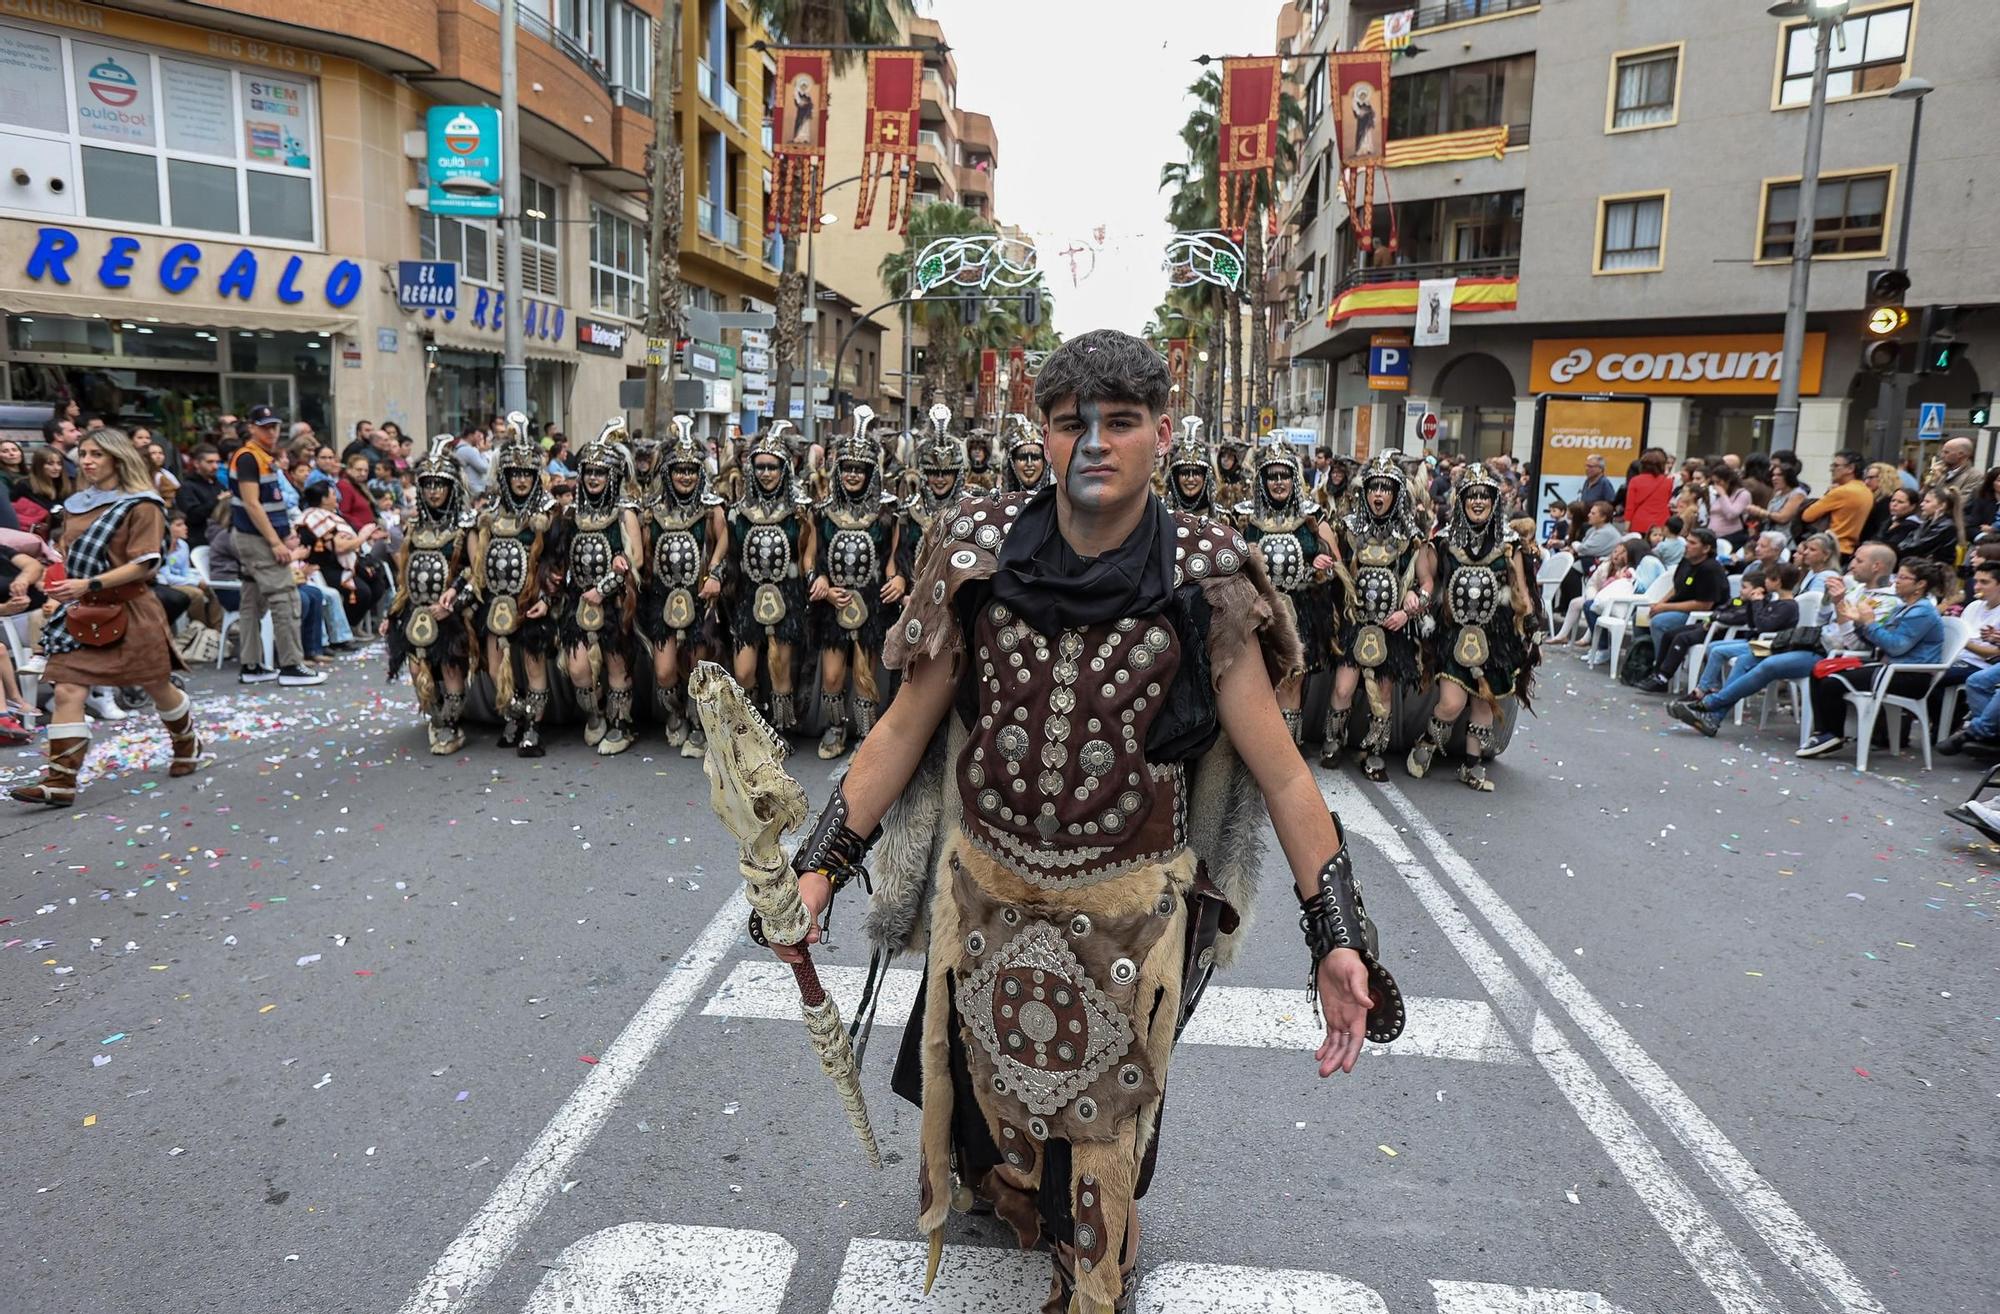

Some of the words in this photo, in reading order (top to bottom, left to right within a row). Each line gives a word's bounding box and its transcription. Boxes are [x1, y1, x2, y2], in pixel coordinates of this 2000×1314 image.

[250, 82, 298, 101] STEM
[80, 107, 147, 127] aulabot
[26, 227, 362, 308] REGALO
[419, 265, 435, 284] EL
[402, 285, 454, 304] REGALO
[473, 286, 565, 340] REALO
[1380, 348, 1400, 373] P
[1596, 351, 1783, 382] consum
[1423, 423, 1437, 432] STOP
[1550, 434, 1633, 450] consum
